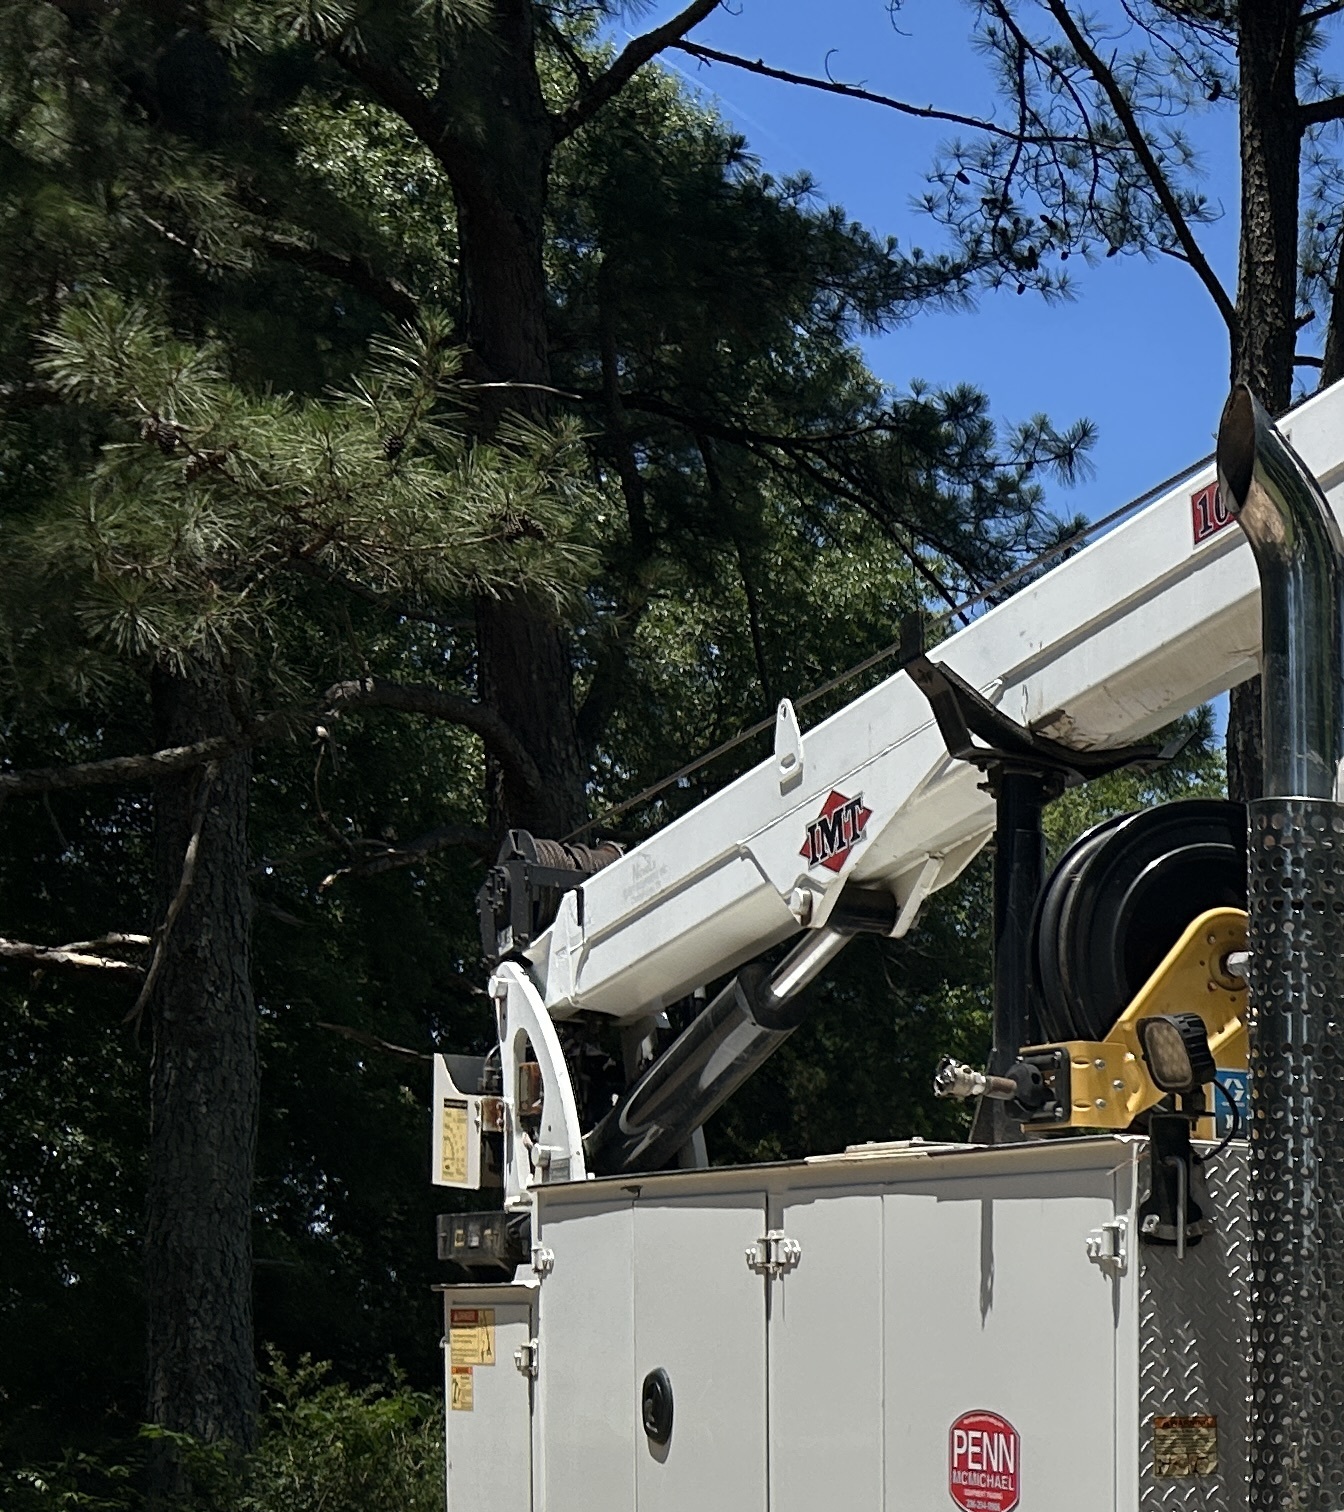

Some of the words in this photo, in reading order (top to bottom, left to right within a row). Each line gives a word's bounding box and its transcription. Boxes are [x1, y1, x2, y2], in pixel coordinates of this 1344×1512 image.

[806, 793, 864, 870] IMT
[953, 1429, 1015, 1474] PENN
[952, 1468, 1015, 1491] MCMICHAEL
